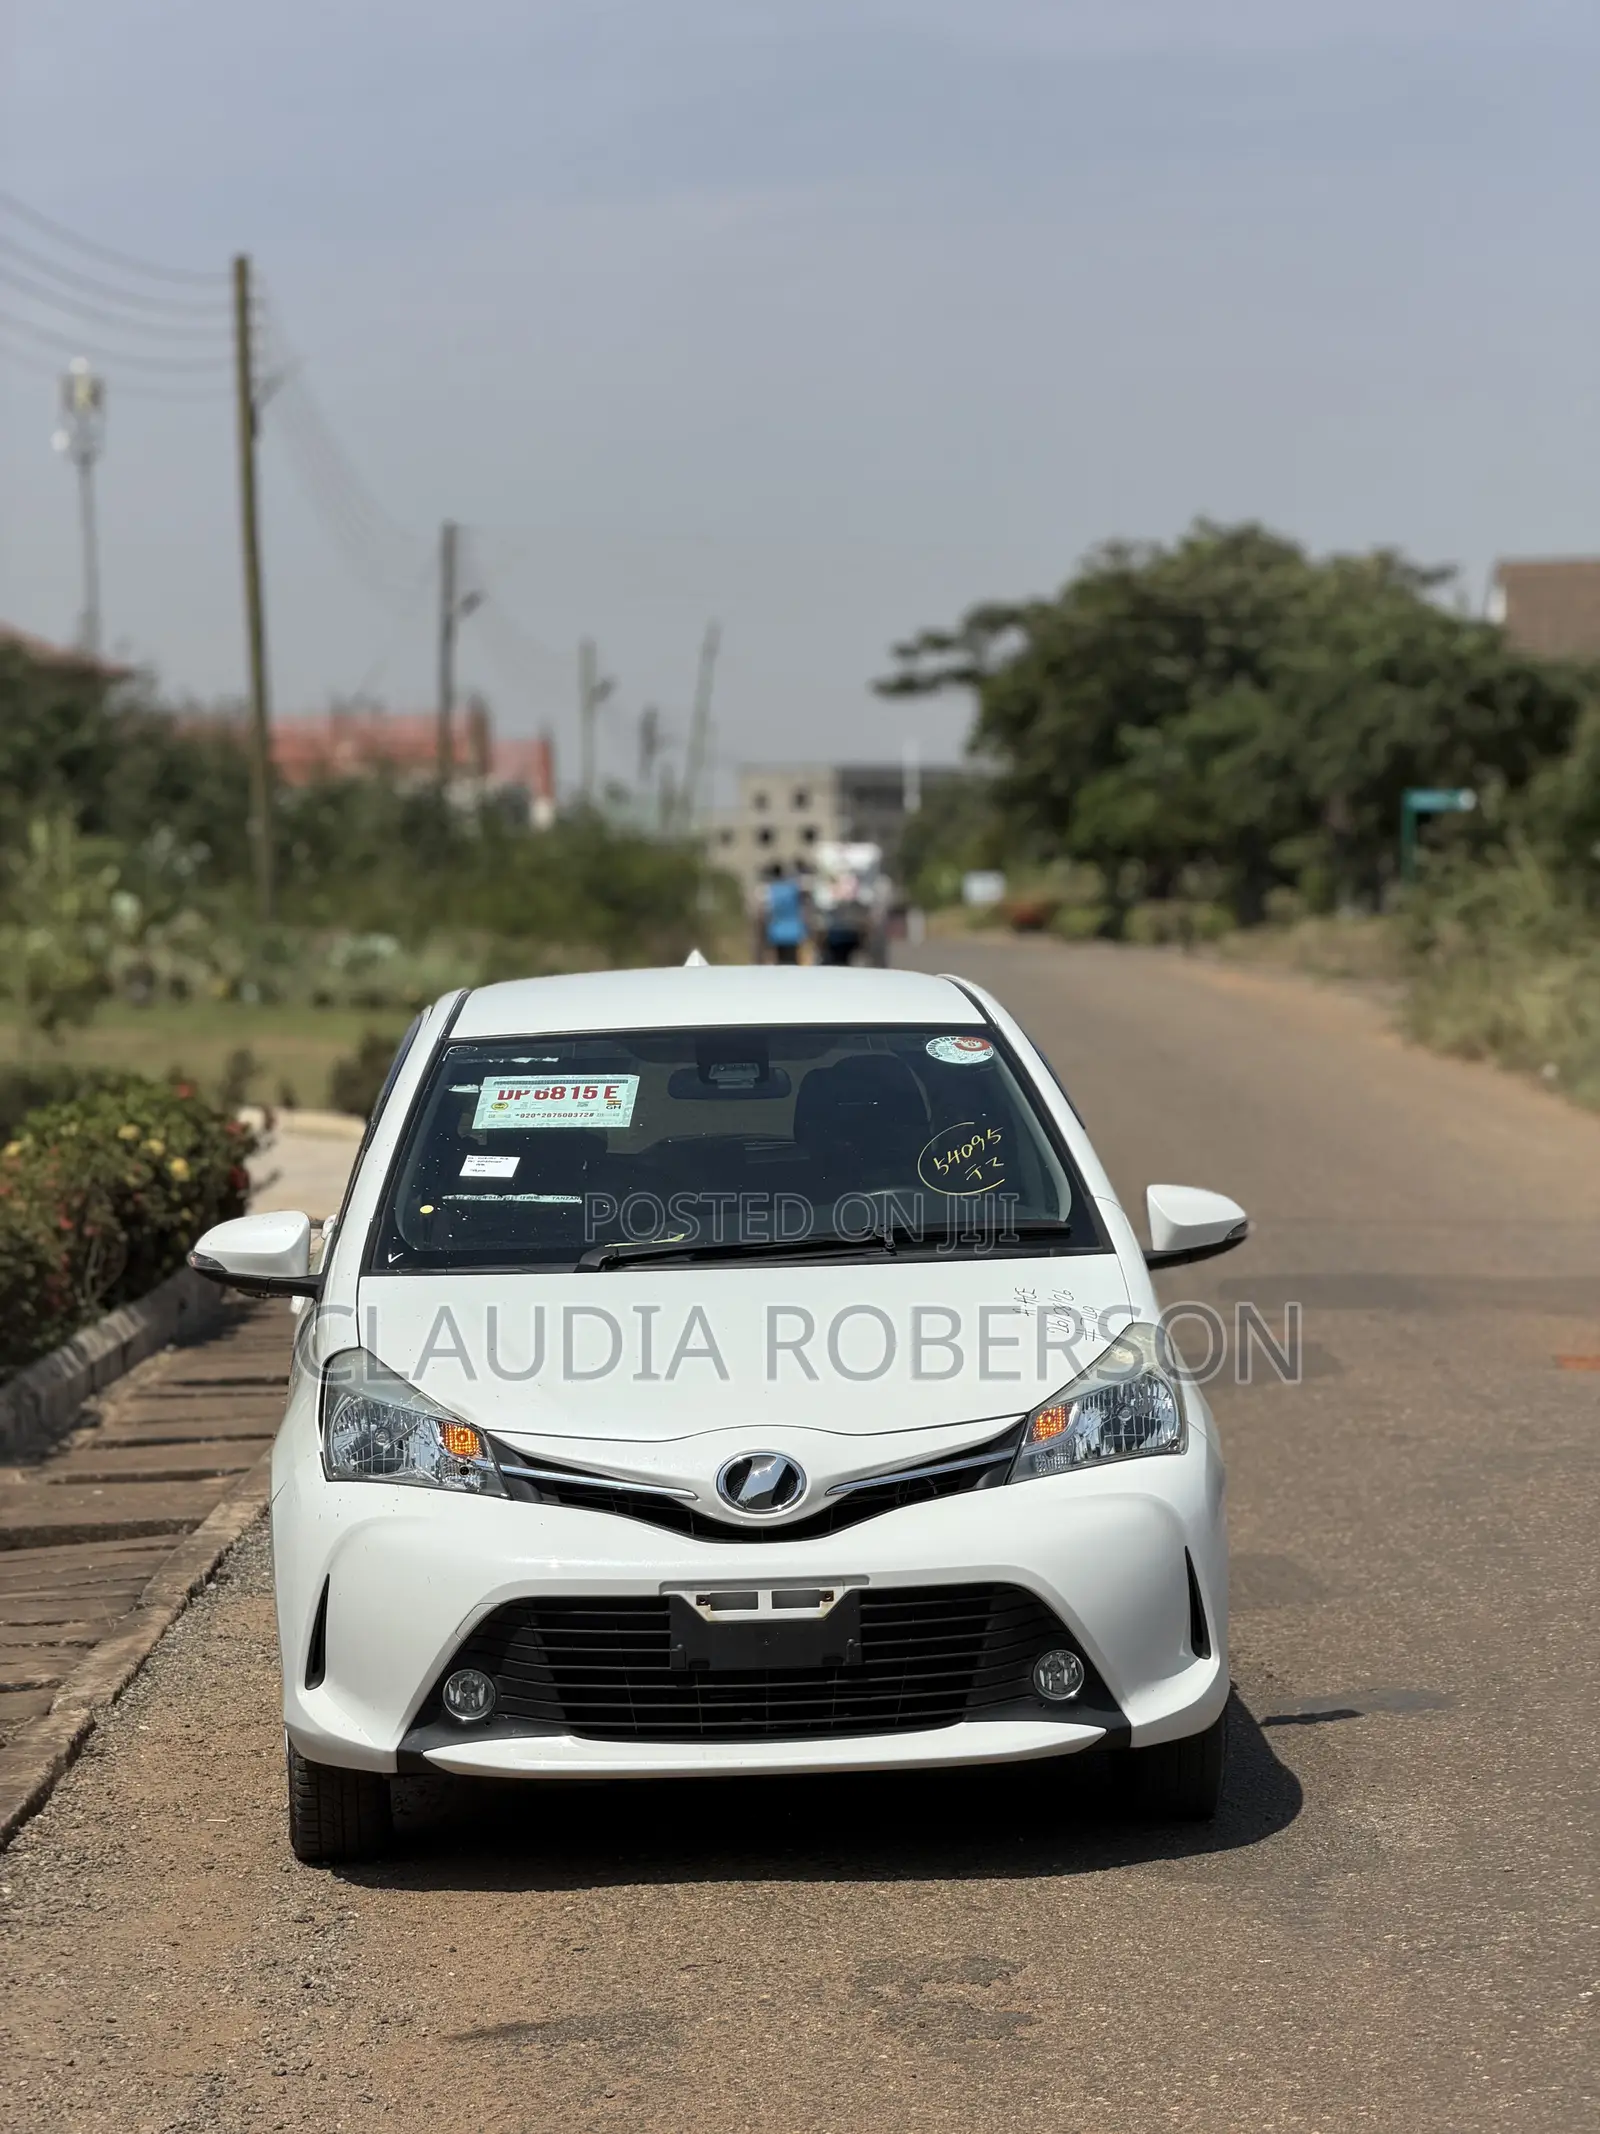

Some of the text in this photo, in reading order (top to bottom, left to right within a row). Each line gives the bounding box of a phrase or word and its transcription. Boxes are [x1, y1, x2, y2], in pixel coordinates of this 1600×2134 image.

[533, 1085, 598, 1100] 6815
[603, 1085, 620, 1099] E
[933, 1126, 1004, 1176] 54095
